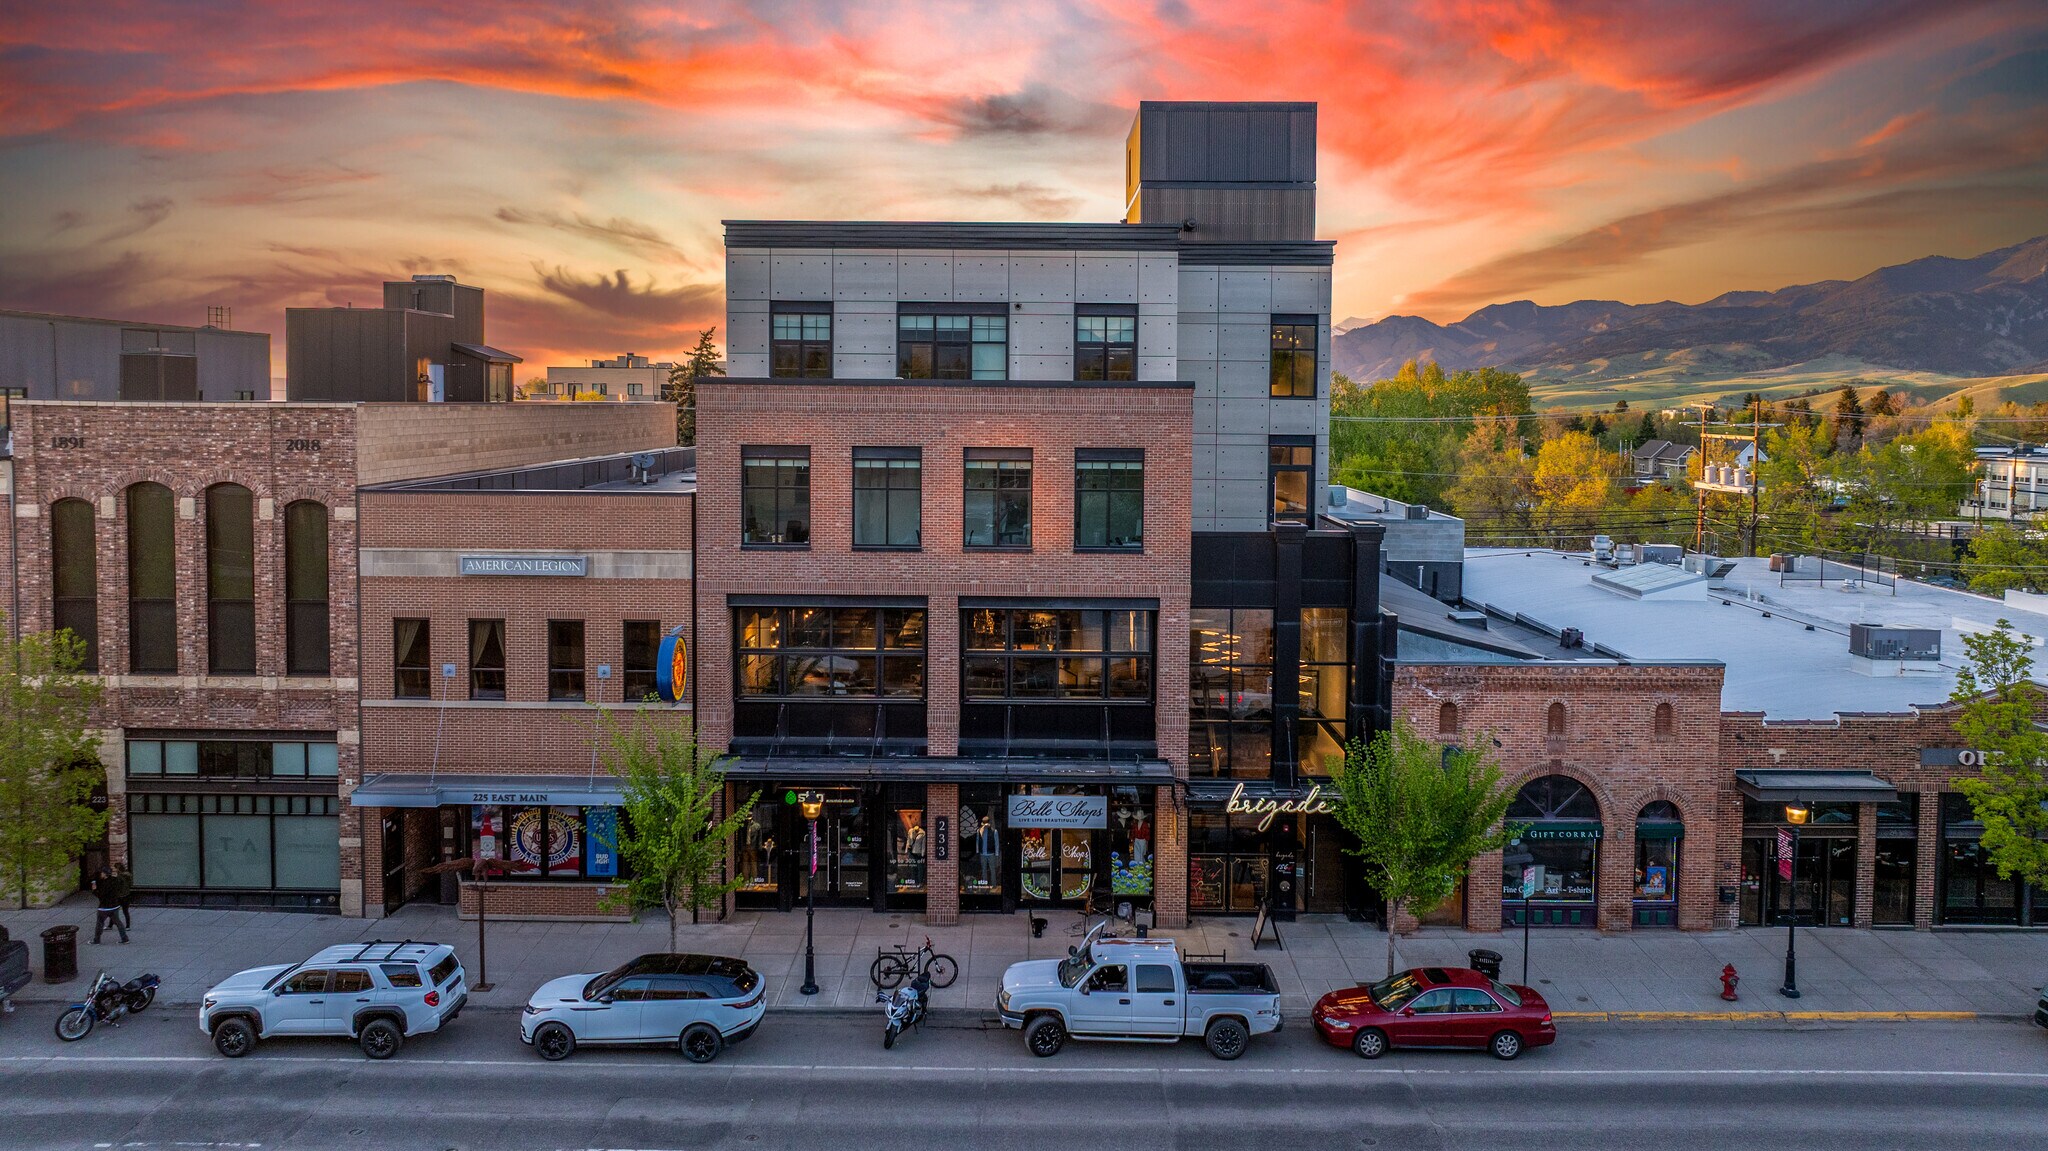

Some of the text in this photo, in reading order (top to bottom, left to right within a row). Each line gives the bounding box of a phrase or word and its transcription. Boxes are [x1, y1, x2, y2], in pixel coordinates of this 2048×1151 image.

[51, 437, 84, 449] 1891
[285, 439, 321, 451] 2018
[466, 560, 581, 571] AMERICAN LEGION
[473, 793, 548, 802] 225 EAST MAIN
[1012, 799, 1104, 825] Belle Shops
[1226, 782, 1335, 832] brigade
[1558, 830, 1601, 838] CORRAL
[1024, 843, 1089, 862] Belle Shops
